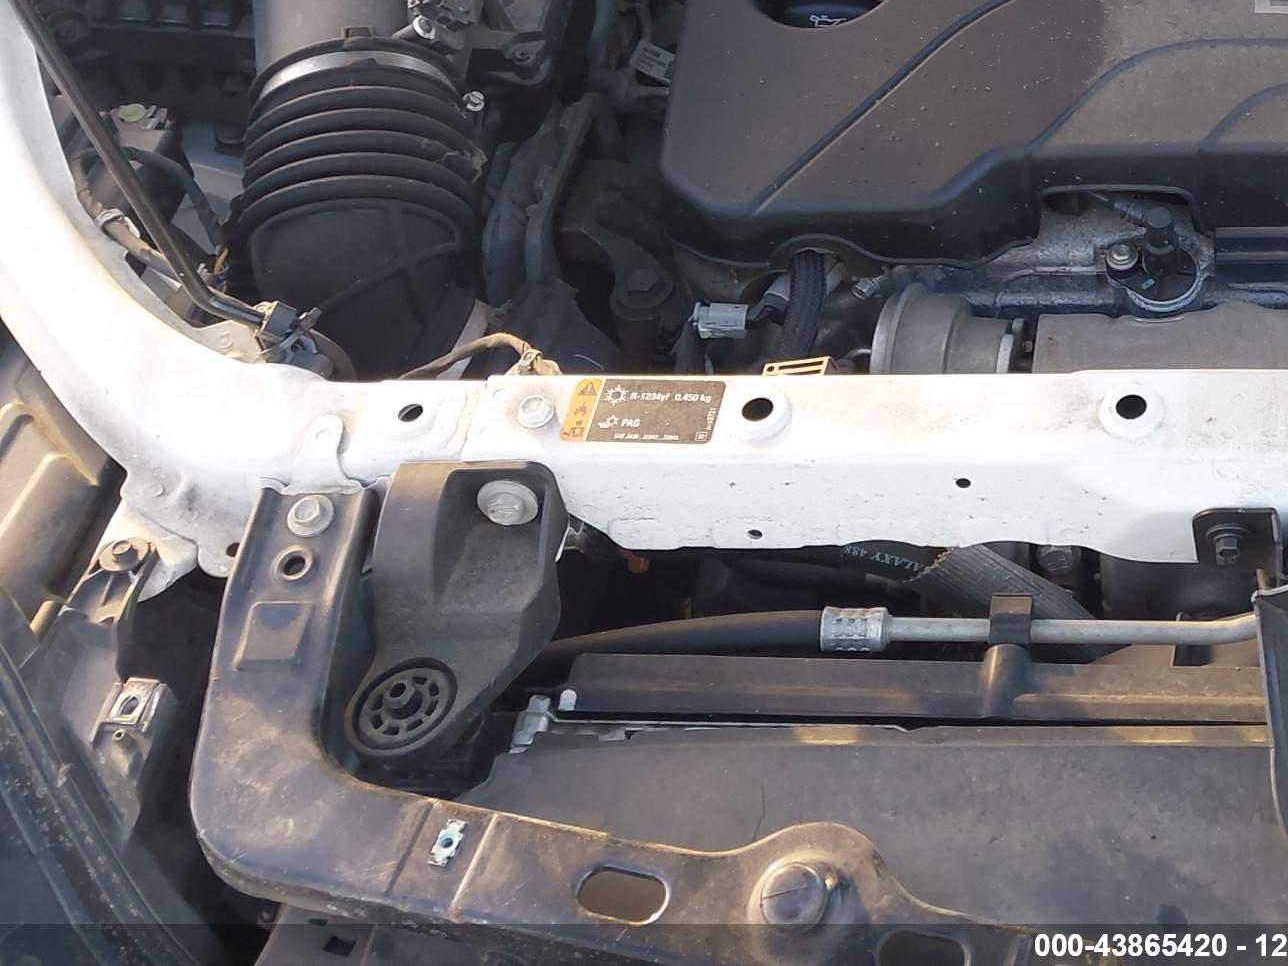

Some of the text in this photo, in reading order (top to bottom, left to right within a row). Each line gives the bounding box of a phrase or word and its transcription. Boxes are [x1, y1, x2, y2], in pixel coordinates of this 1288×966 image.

[630, 392, 712, 404] R-1234yf 0.450 kg
[621, 419, 640, 427] PAG
[870, 552, 926, 573] ALAXY
